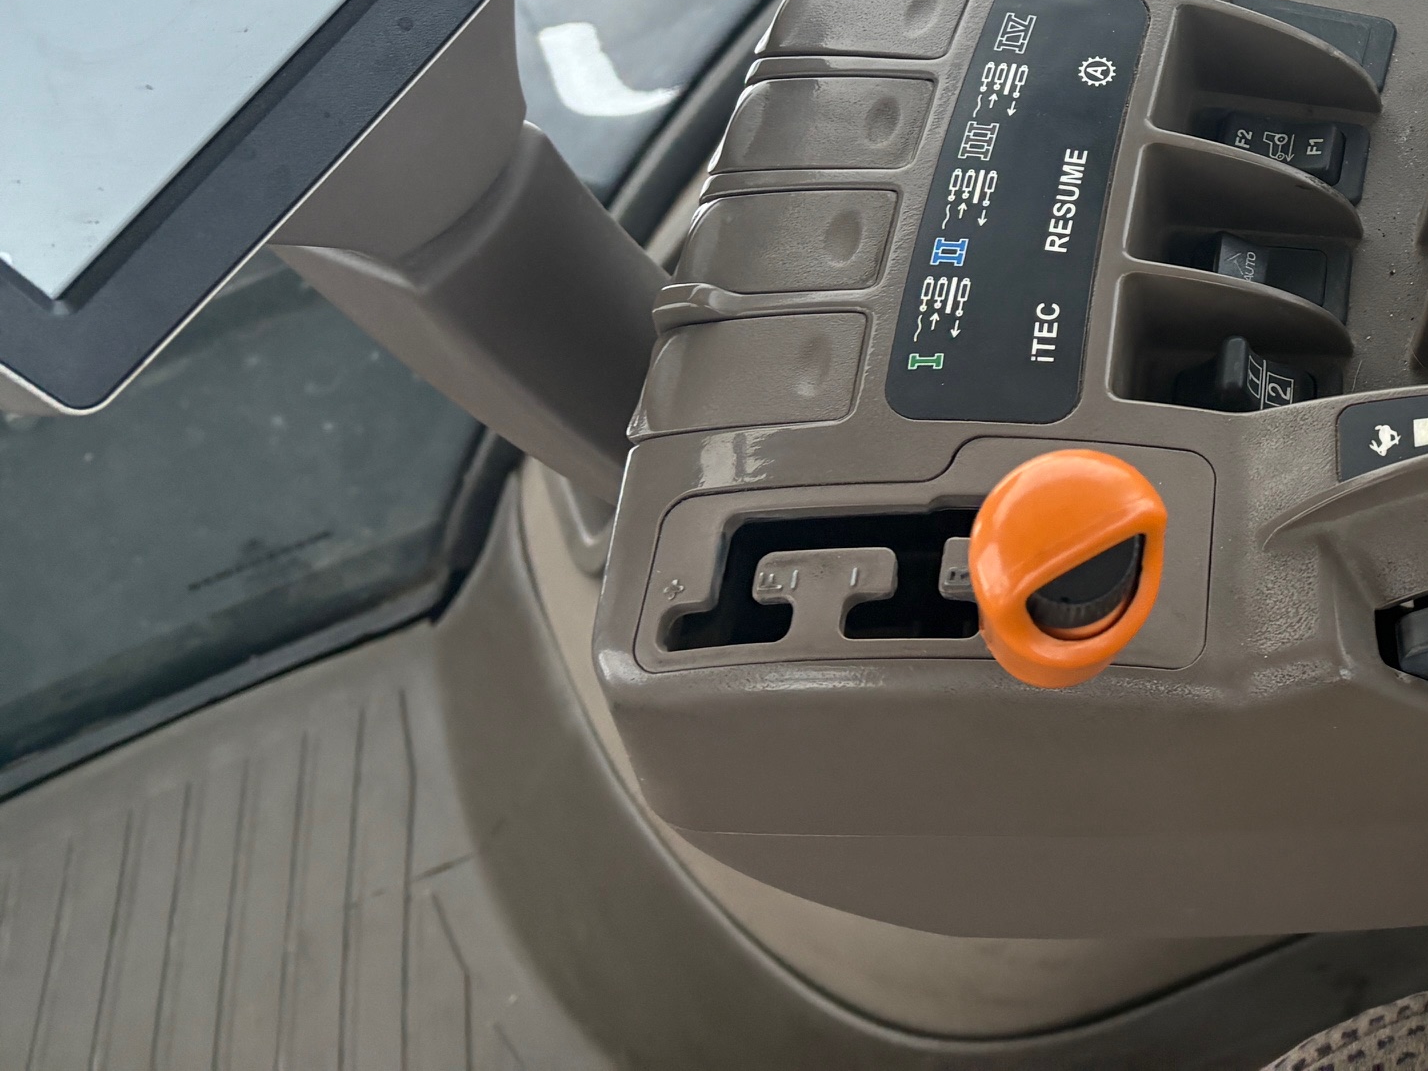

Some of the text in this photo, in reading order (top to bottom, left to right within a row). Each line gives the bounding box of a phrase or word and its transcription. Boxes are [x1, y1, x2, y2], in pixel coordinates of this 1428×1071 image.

[1234, 129, 1253, 149] F2
[1306, 138, 1324, 156] F1
[1044, 148, 1088, 253] RESUME
[1030, 302, 1061, 363] iTEC
